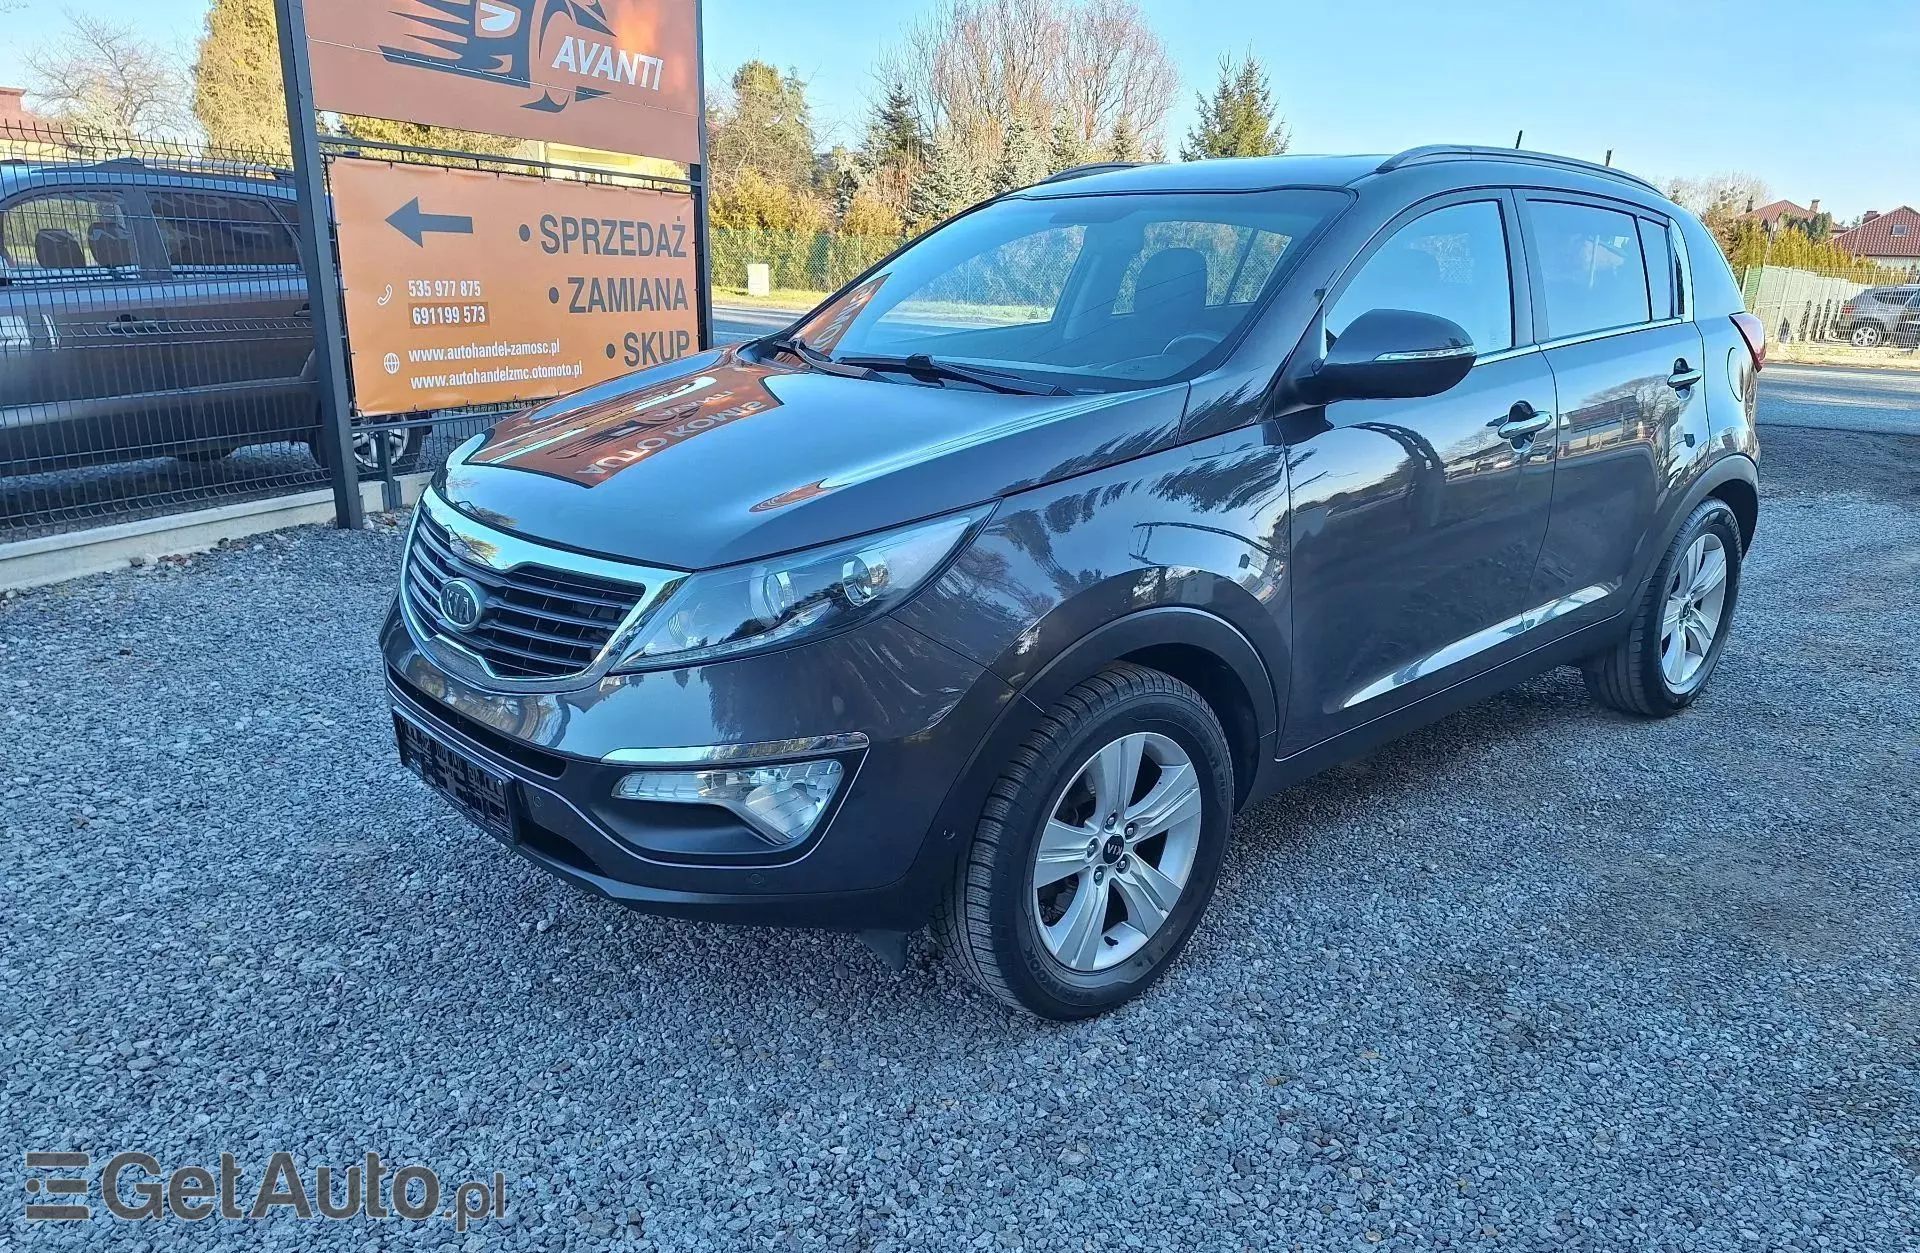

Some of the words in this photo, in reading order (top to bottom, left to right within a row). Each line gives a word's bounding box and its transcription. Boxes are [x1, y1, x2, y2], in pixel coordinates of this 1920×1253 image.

[551, 35, 664, 91] AVANTI
[539, 214, 687, 258] SPRZEDAŻ
[408, 280, 432, 297] 535
[435, 280, 456, 297] 977
[460, 280, 481, 297] 875
[567, 276, 689, 314] ZAMIANA
[463, 305, 486, 323] 573
[408, 338, 560, 363] www.autohandel-zamosc.pl
[623, 330, 690, 368] SKUP
[410, 360, 583, 389] www.autohandelzmc.otomoto.pl
